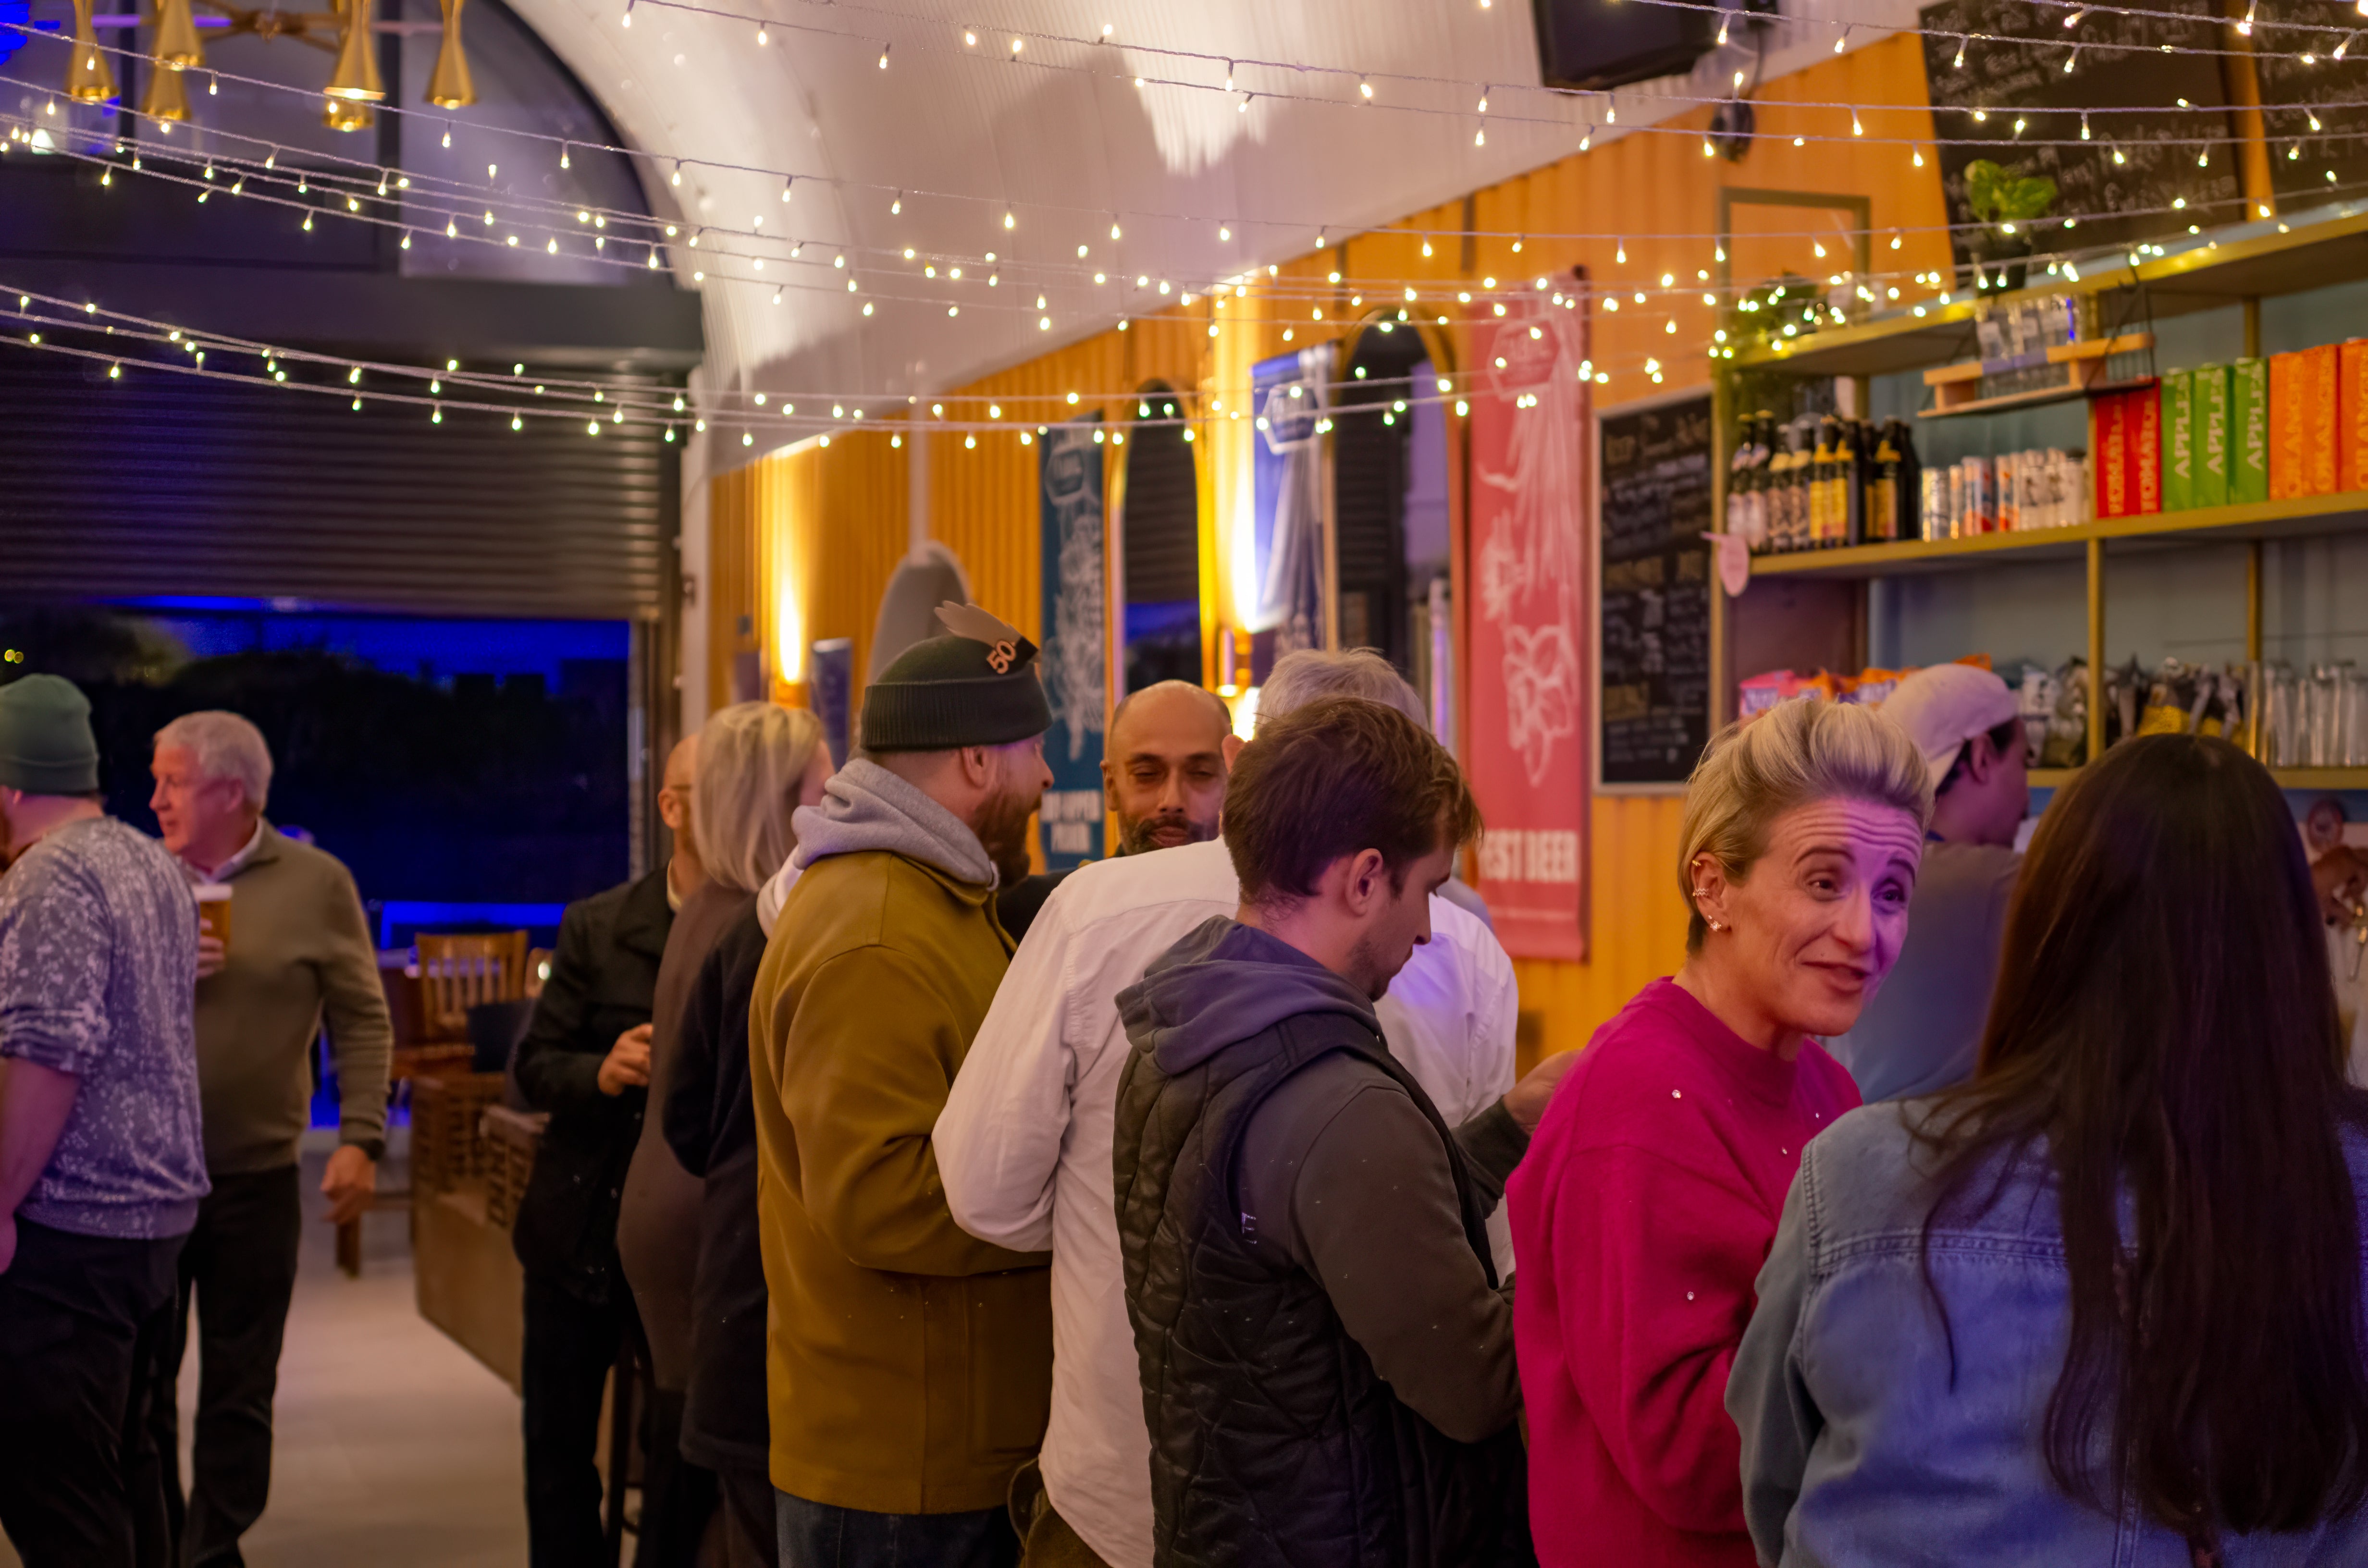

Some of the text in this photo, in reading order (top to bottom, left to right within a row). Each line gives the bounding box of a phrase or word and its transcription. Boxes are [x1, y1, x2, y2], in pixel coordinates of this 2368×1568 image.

[2174, 374, 2191, 478] APPLES
[2207, 368, 2224, 475] APPLES
[2247, 362, 2264, 471] APPLES
[987, 640, 1016, 674] 50
